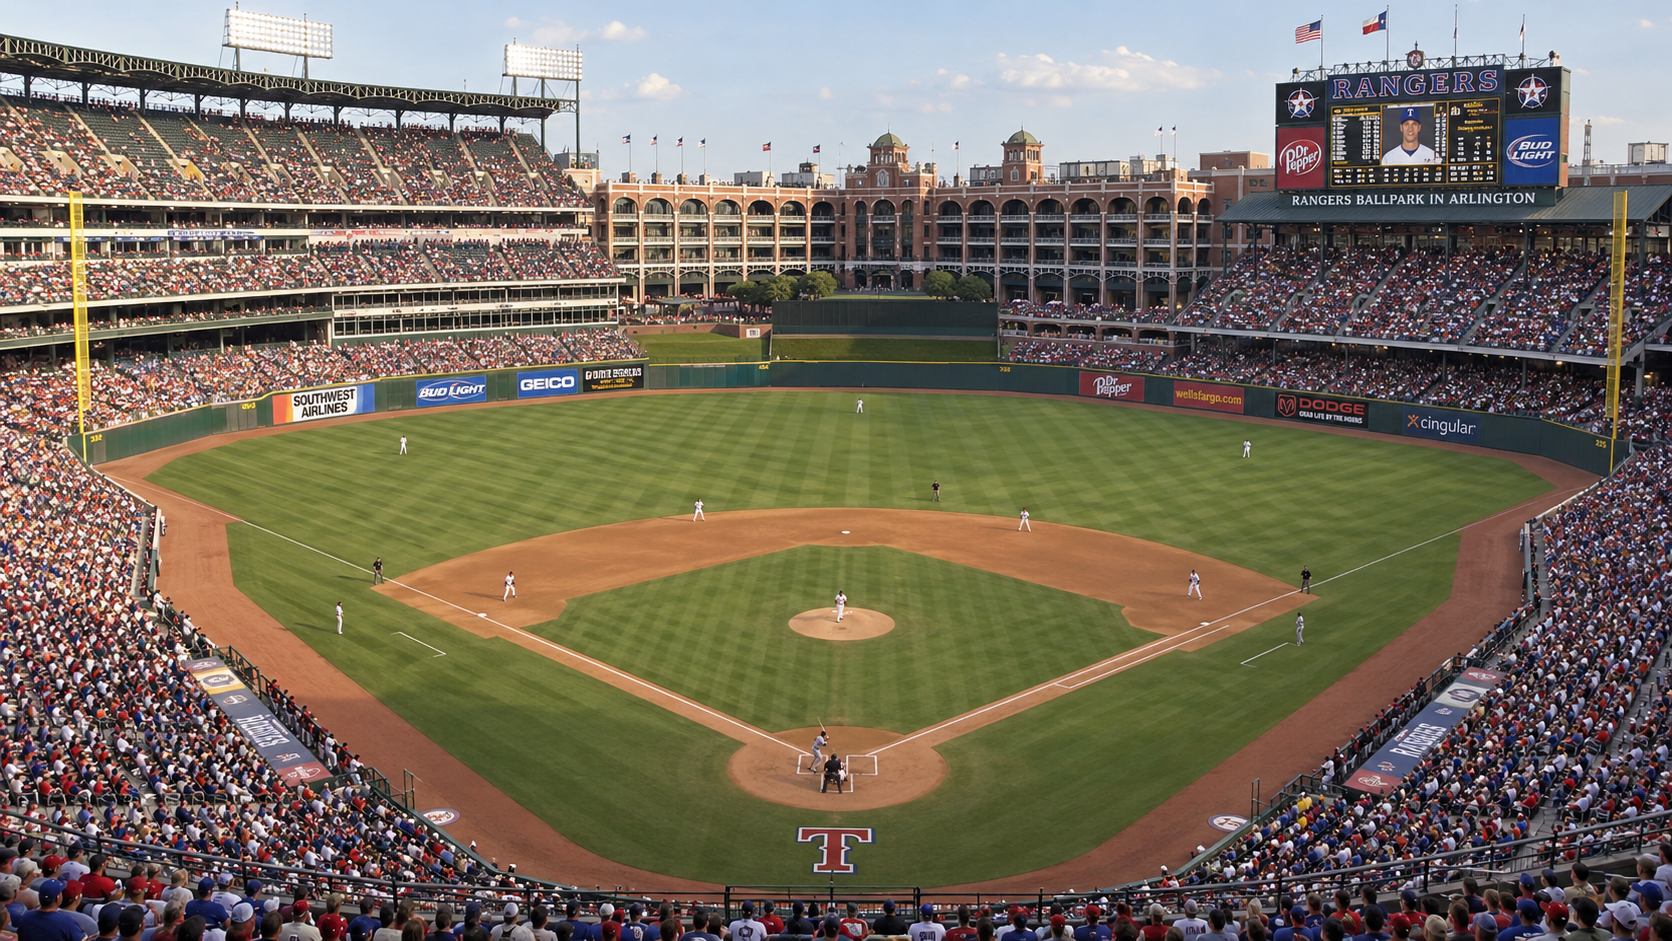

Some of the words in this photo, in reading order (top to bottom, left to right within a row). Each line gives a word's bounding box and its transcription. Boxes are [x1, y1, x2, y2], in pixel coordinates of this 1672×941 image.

[1332, 70, 1498, 99] RANGERS
[1296, 145, 1308, 159] Dr
[1518, 141, 1552, 150] BUD
[1286, 149, 1318, 174] Pepper
[1512, 151, 1555, 160] LIGHT
[1292, 195, 1352, 206] RANGERS
[1356, 194, 1425, 205] BALLPARK
[1429, 194, 1444, 204] IN
[1448, 192, 1536, 204] ARLINGTON
[520, 376, 575, 391] GEICO
[1105, 375, 1119, 386] Dr
[293, 388, 356, 407] SOUTHWEST
[418, 387, 448, 398] BUD
[448, 382, 486, 396] LIGHT
[1175, 389, 1242, 405] wellsfargo.com
[301, 401, 349, 418] AIRLINES
[1299, 398, 1365, 415] DODGE
[1420, 415, 1474, 436] cingular
[796, 826, 876, 875] T
